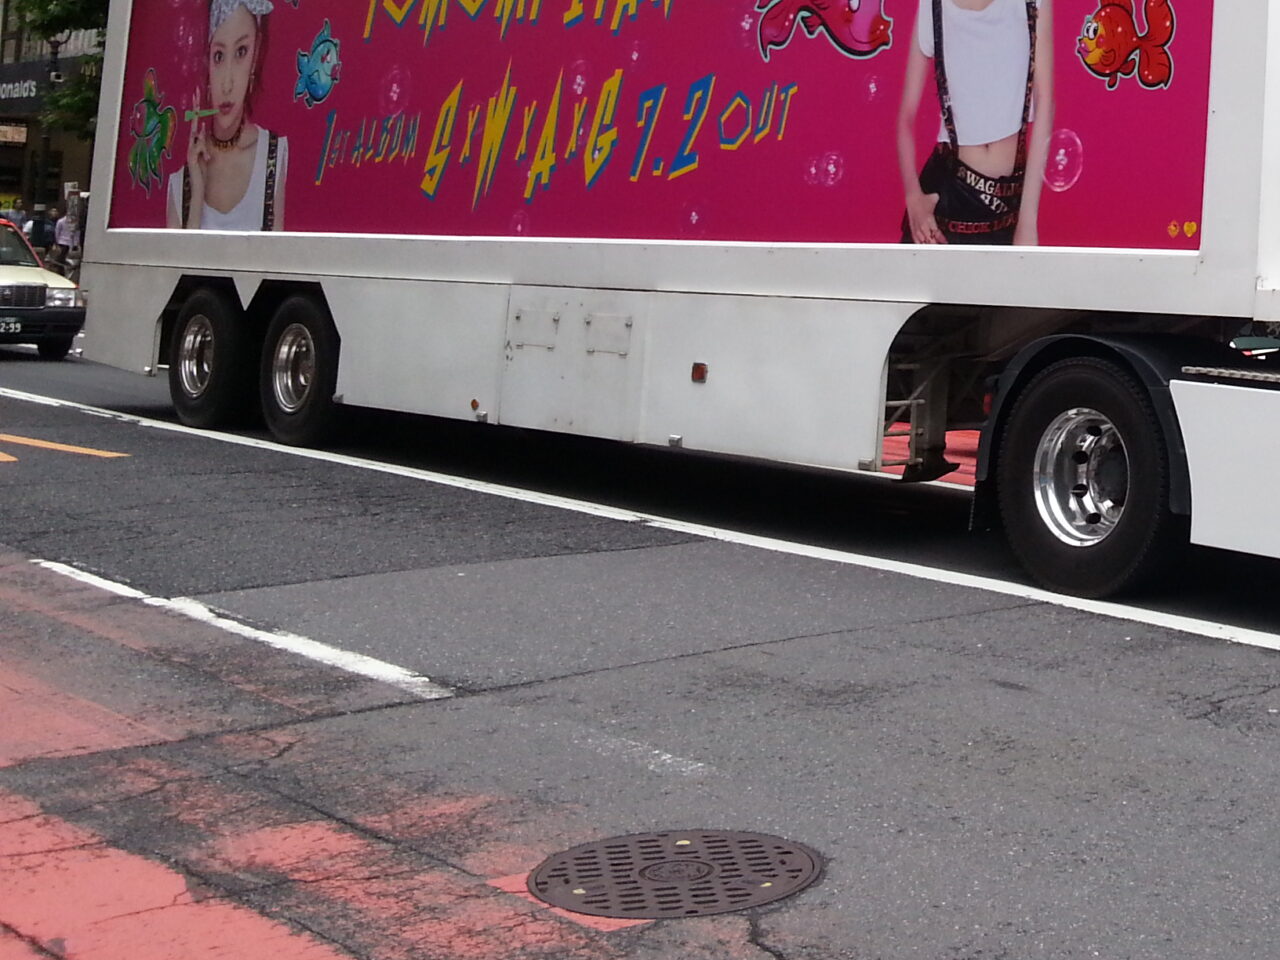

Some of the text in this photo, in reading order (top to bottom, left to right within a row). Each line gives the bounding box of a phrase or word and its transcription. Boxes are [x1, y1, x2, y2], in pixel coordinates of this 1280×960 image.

[351, 110, 422, 167] ALBUM
[629, 72, 717, 183] 7.2
[718, 78, 798, 153] OUT
